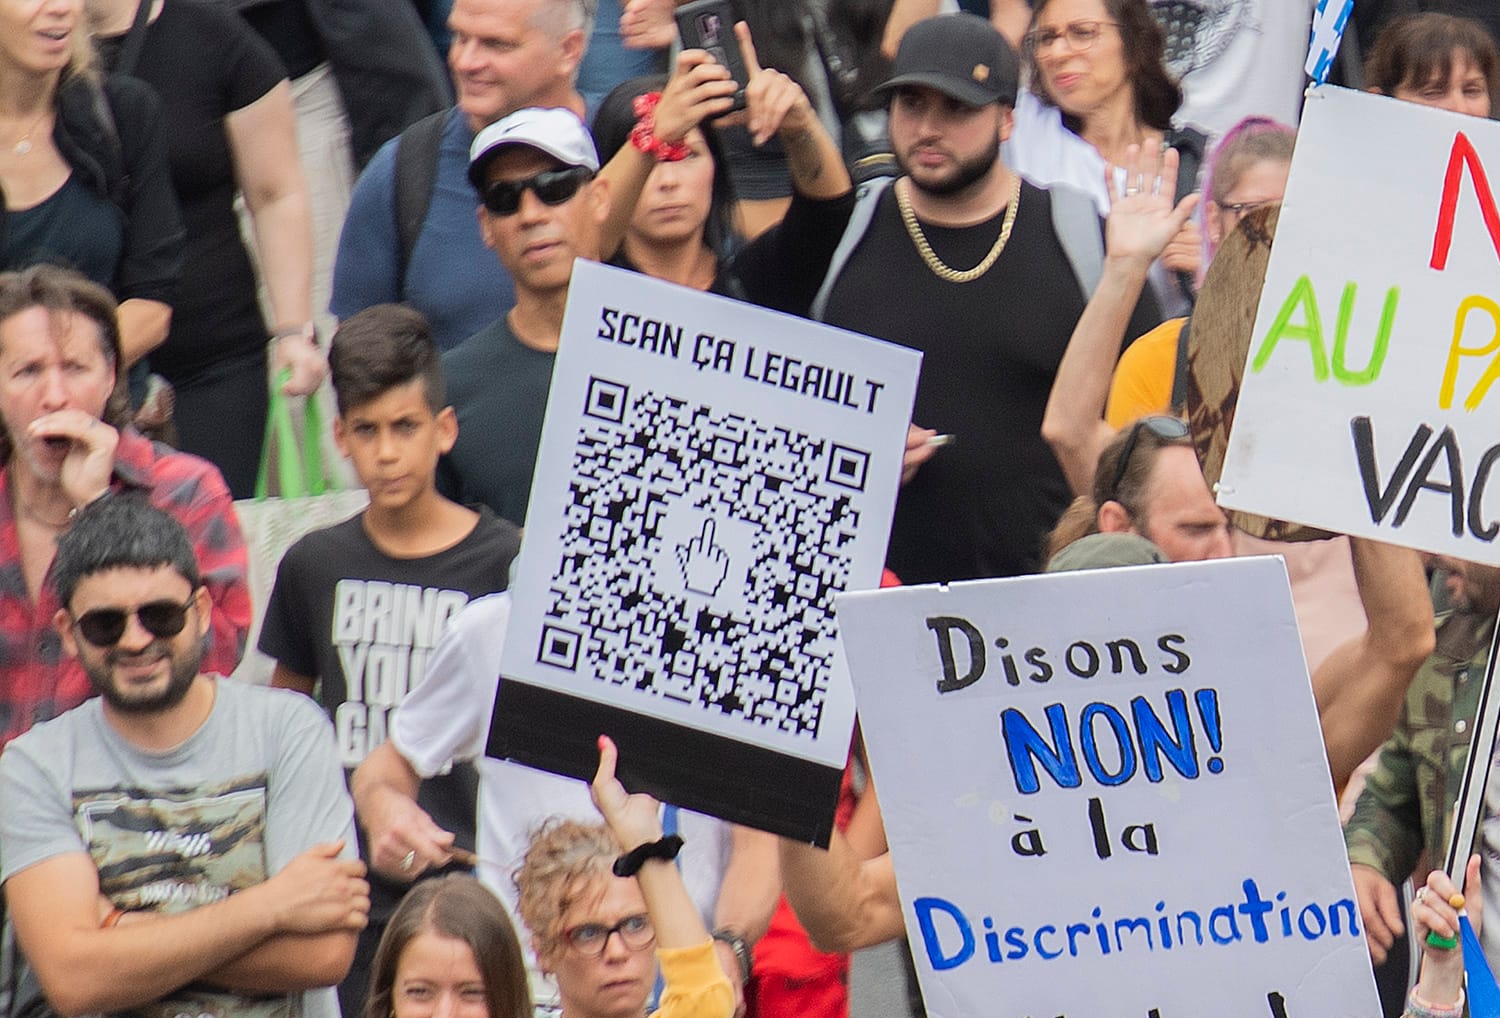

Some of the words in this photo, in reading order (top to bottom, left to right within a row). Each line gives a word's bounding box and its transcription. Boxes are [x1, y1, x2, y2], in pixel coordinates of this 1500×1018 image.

[598, 306, 683, 359] SCAN
[691, 333, 736, 371] ÇA
[743, 346, 885, 414] LEGAULT
[1252, 274, 1400, 386] AU
[926, 616, 1190, 694] Disons
[1001, 688, 1225, 794] NON!
[1011, 814, 1047, 857] à
[1088, 797, 1159, 859] la
[913, 878, 1360, 971] Discrimination
